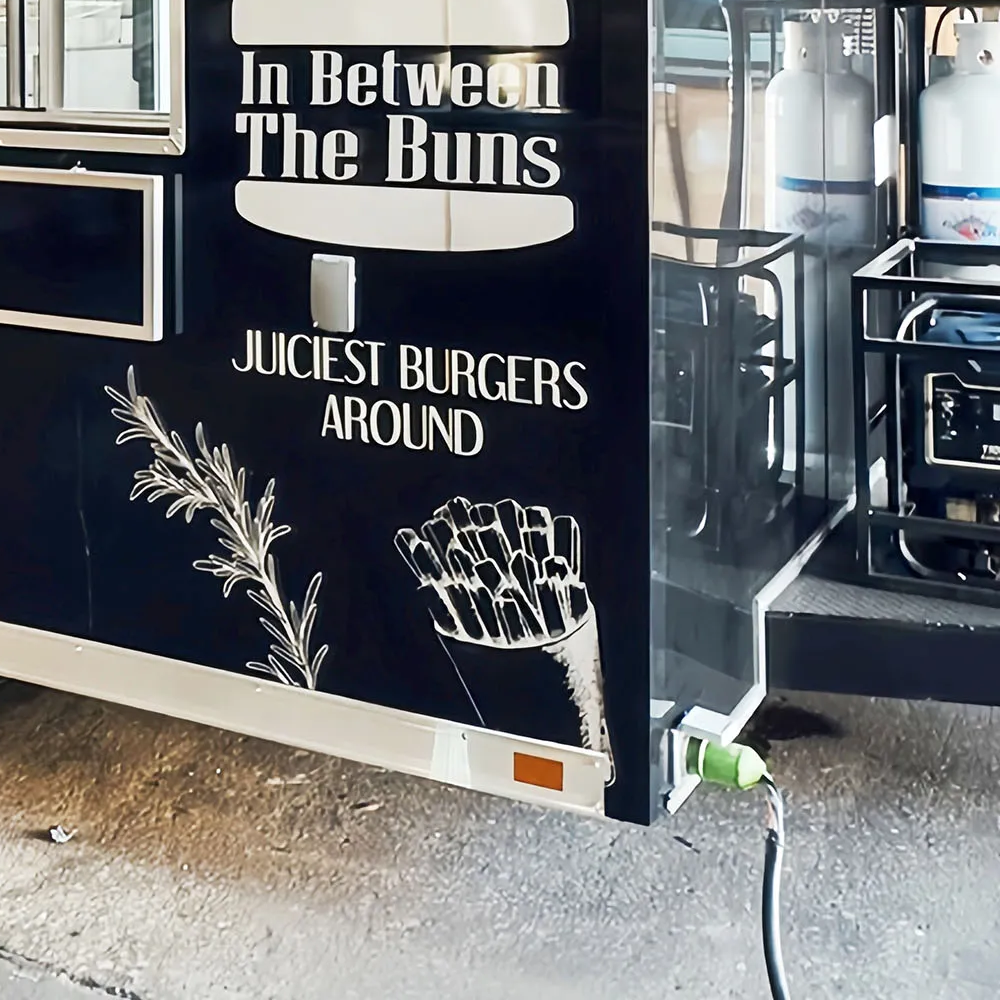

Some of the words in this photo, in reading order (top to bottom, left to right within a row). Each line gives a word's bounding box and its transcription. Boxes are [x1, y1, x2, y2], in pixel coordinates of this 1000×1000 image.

[241, 51, 289, 105] In
[309, 50, 560, 109] Between
[235, 112, 359, 180] The
[385, 114, 561, 188] Buns
[231, 329, 386, 386] JUICIEST
[400, 344, 589, 411] BURGERS
[321, 394, 484, 457] AROUND
